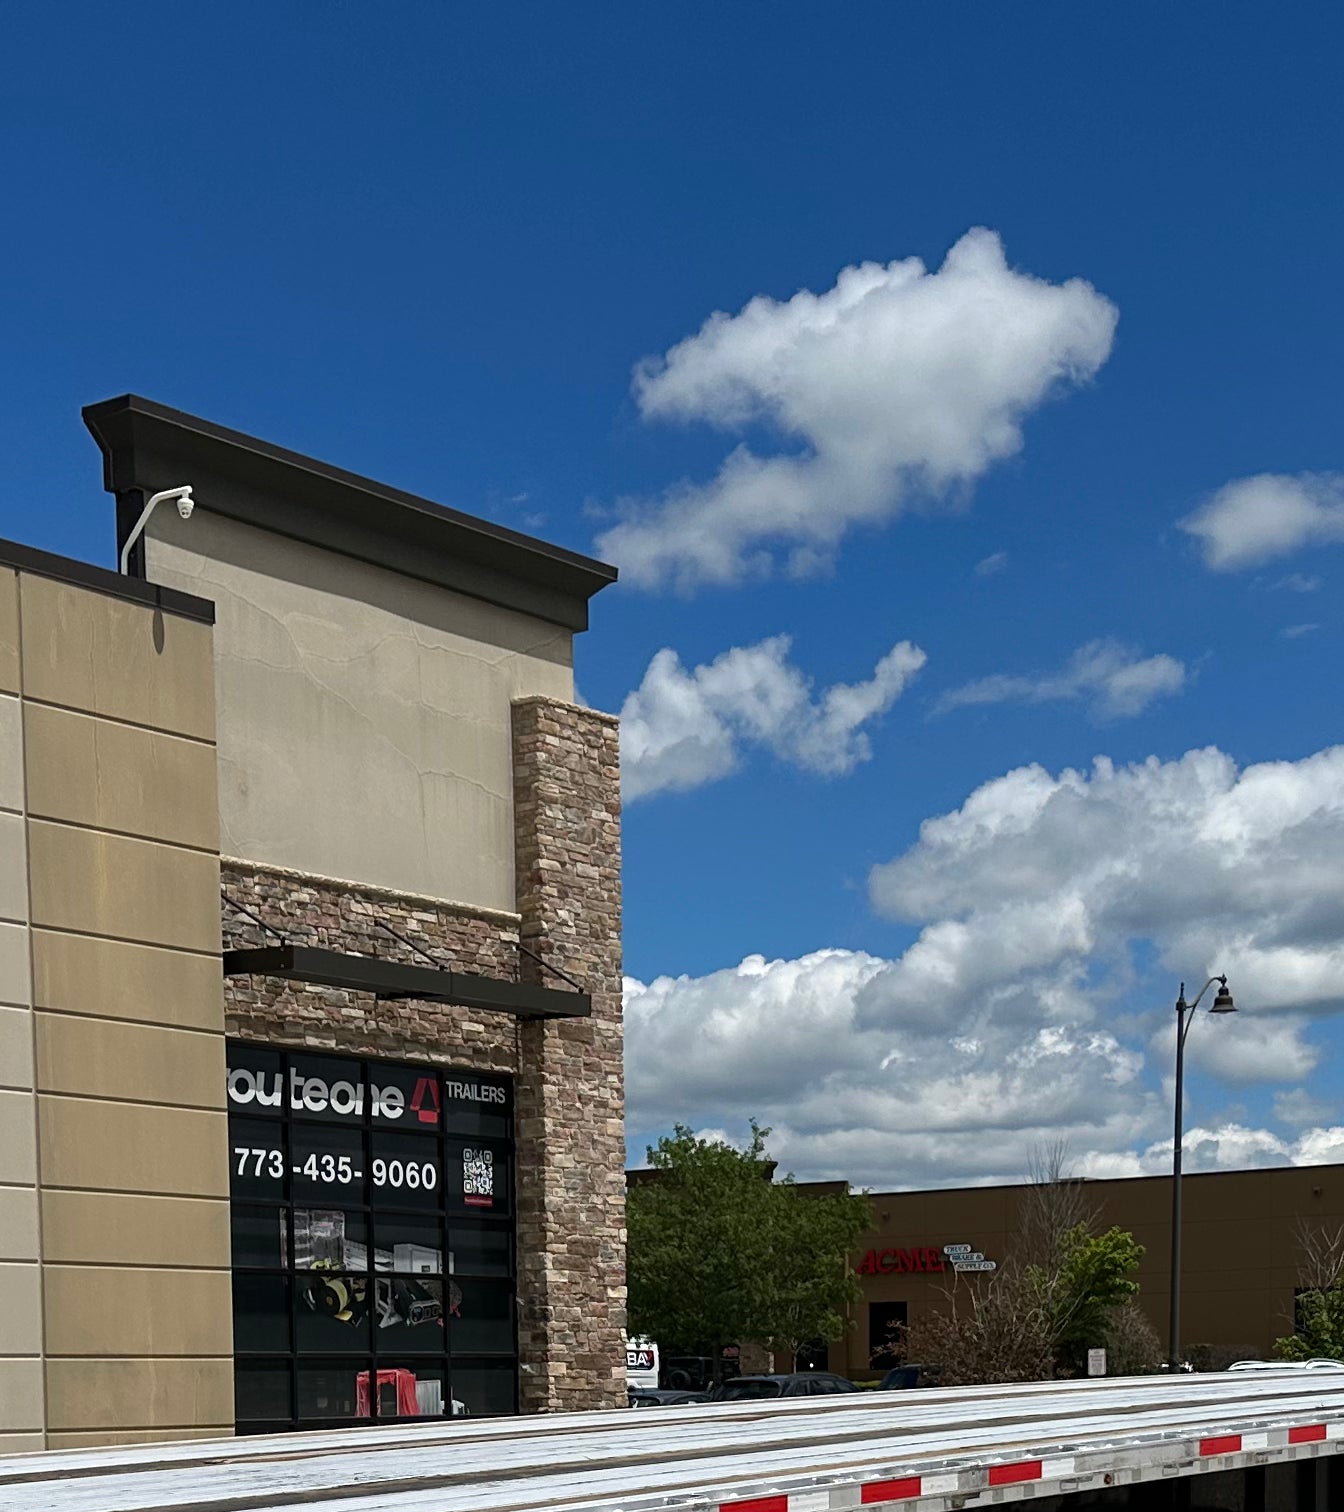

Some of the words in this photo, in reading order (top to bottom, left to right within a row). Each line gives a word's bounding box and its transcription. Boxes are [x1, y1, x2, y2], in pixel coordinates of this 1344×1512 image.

[226, 1067, 405, 1119] outeone
[445, 1081, 506, 1104] TRAILERS
[857, 1247, 944, 1275] ACME
